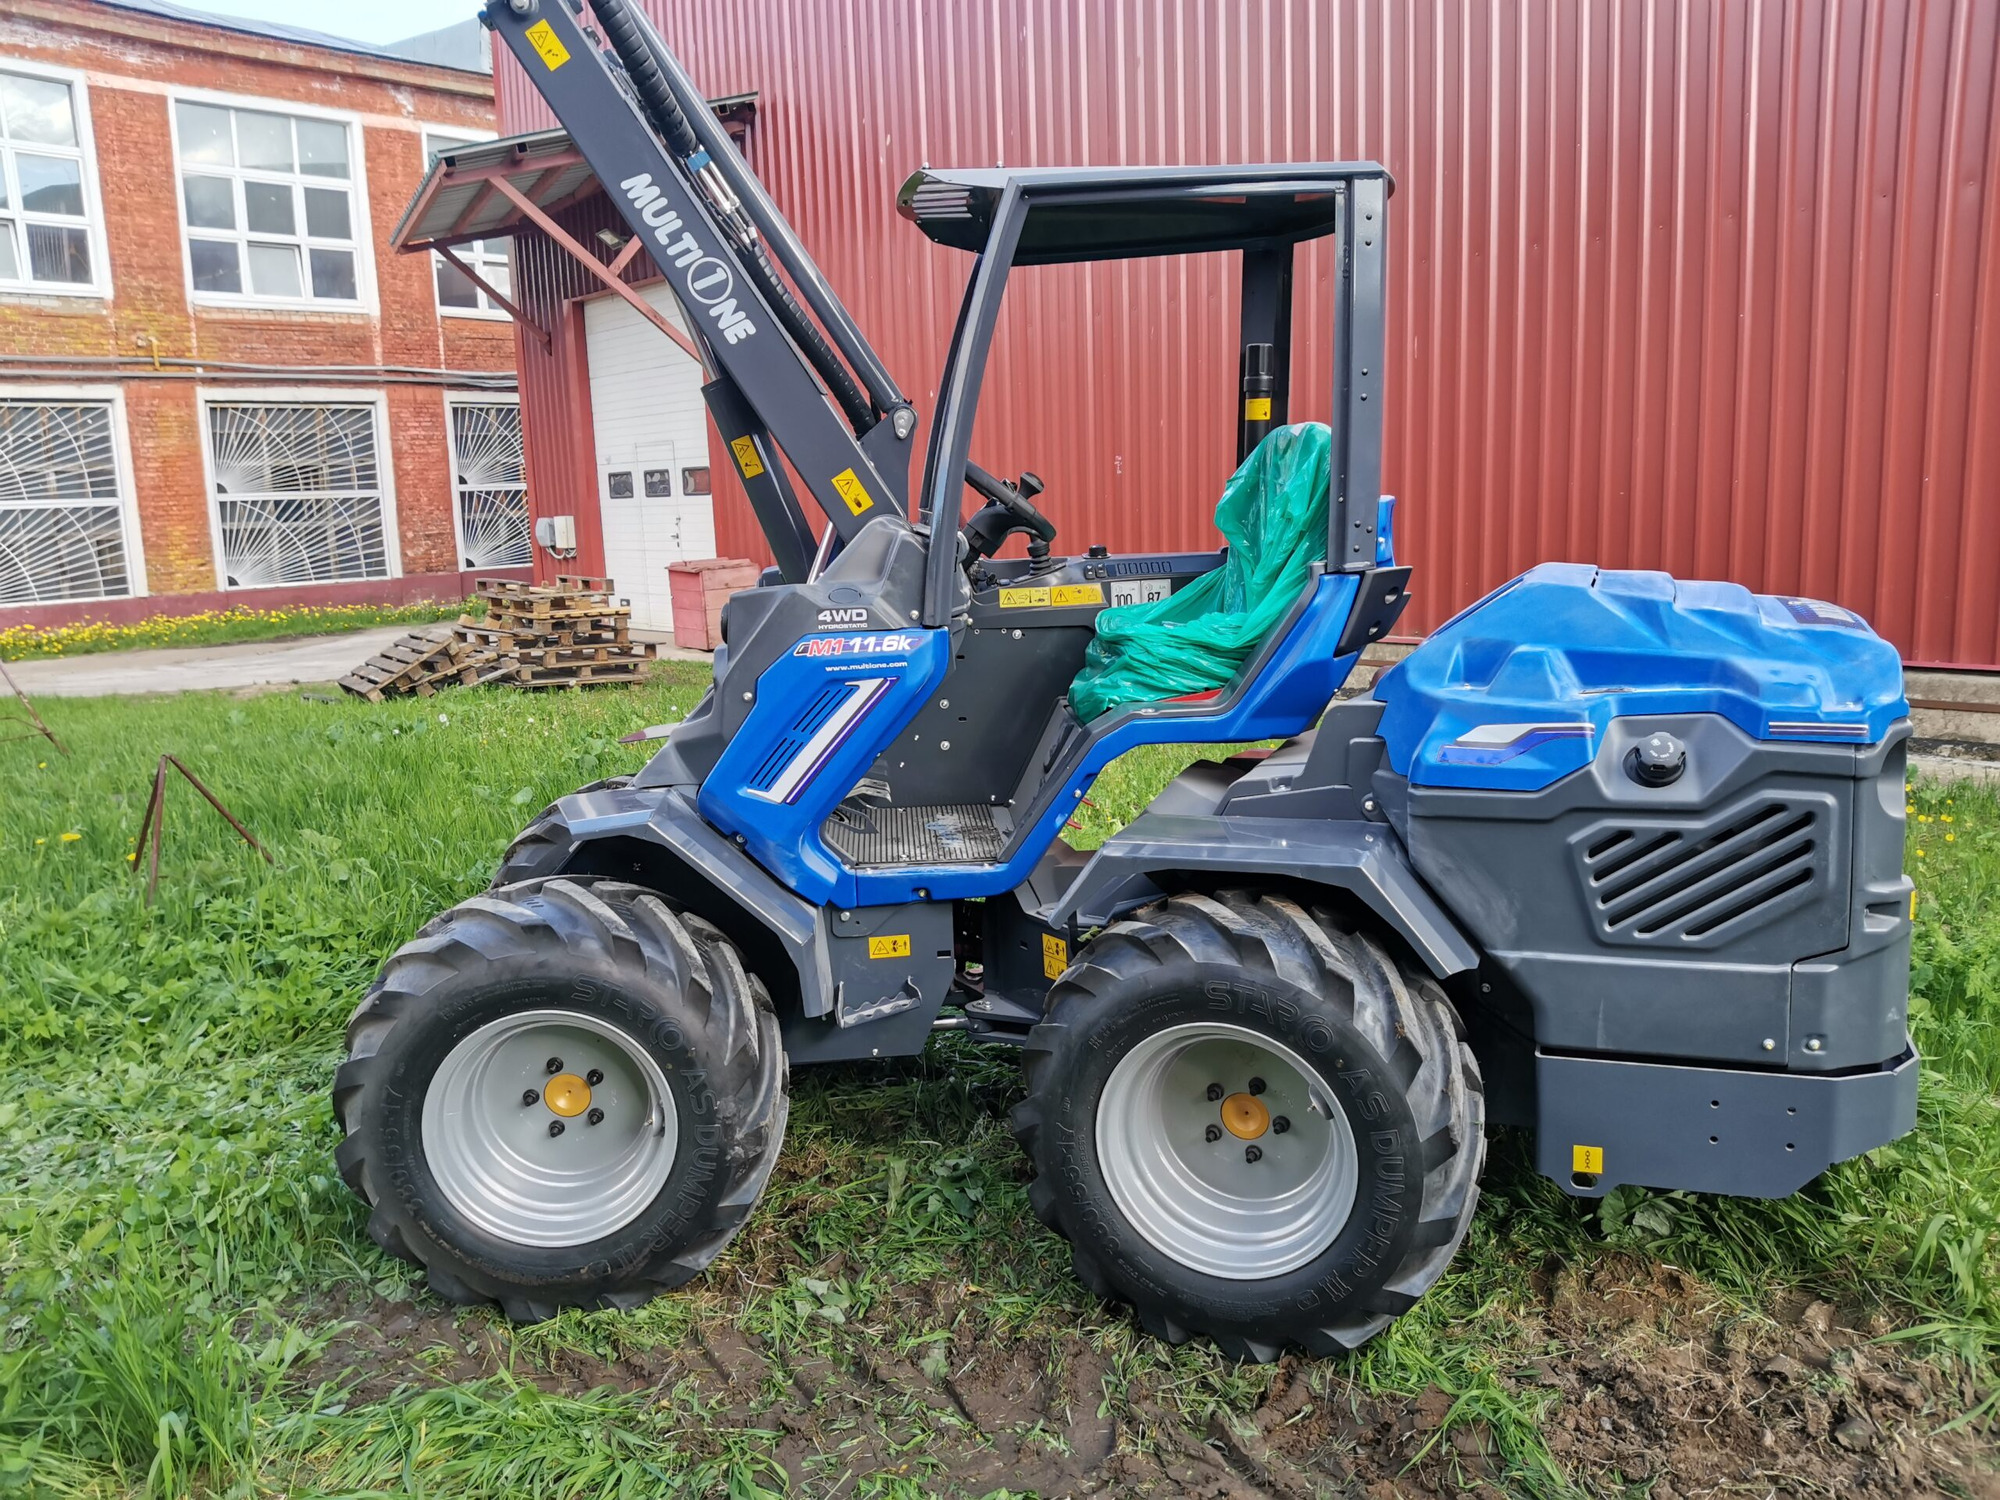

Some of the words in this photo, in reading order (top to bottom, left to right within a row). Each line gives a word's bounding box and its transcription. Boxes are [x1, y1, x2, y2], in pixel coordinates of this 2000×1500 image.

[1114, 592, 1133, 608] 100
[817, 608, 868, 622] 4WD
[818, 622, 868, 630] HYDROSTATIC
[807, 637, 845, 657] M1
[849, 634, 911, 654] 11.6k
[825, 661, 908, 672] www.multione.com
[680, 1068, 718, 1115] AS
[1338, 1068, 1391, 1121] AS
[640, 1124, 723, 1252] DUMPER
[1348, 1129, 1406, 1278] DUMPER
